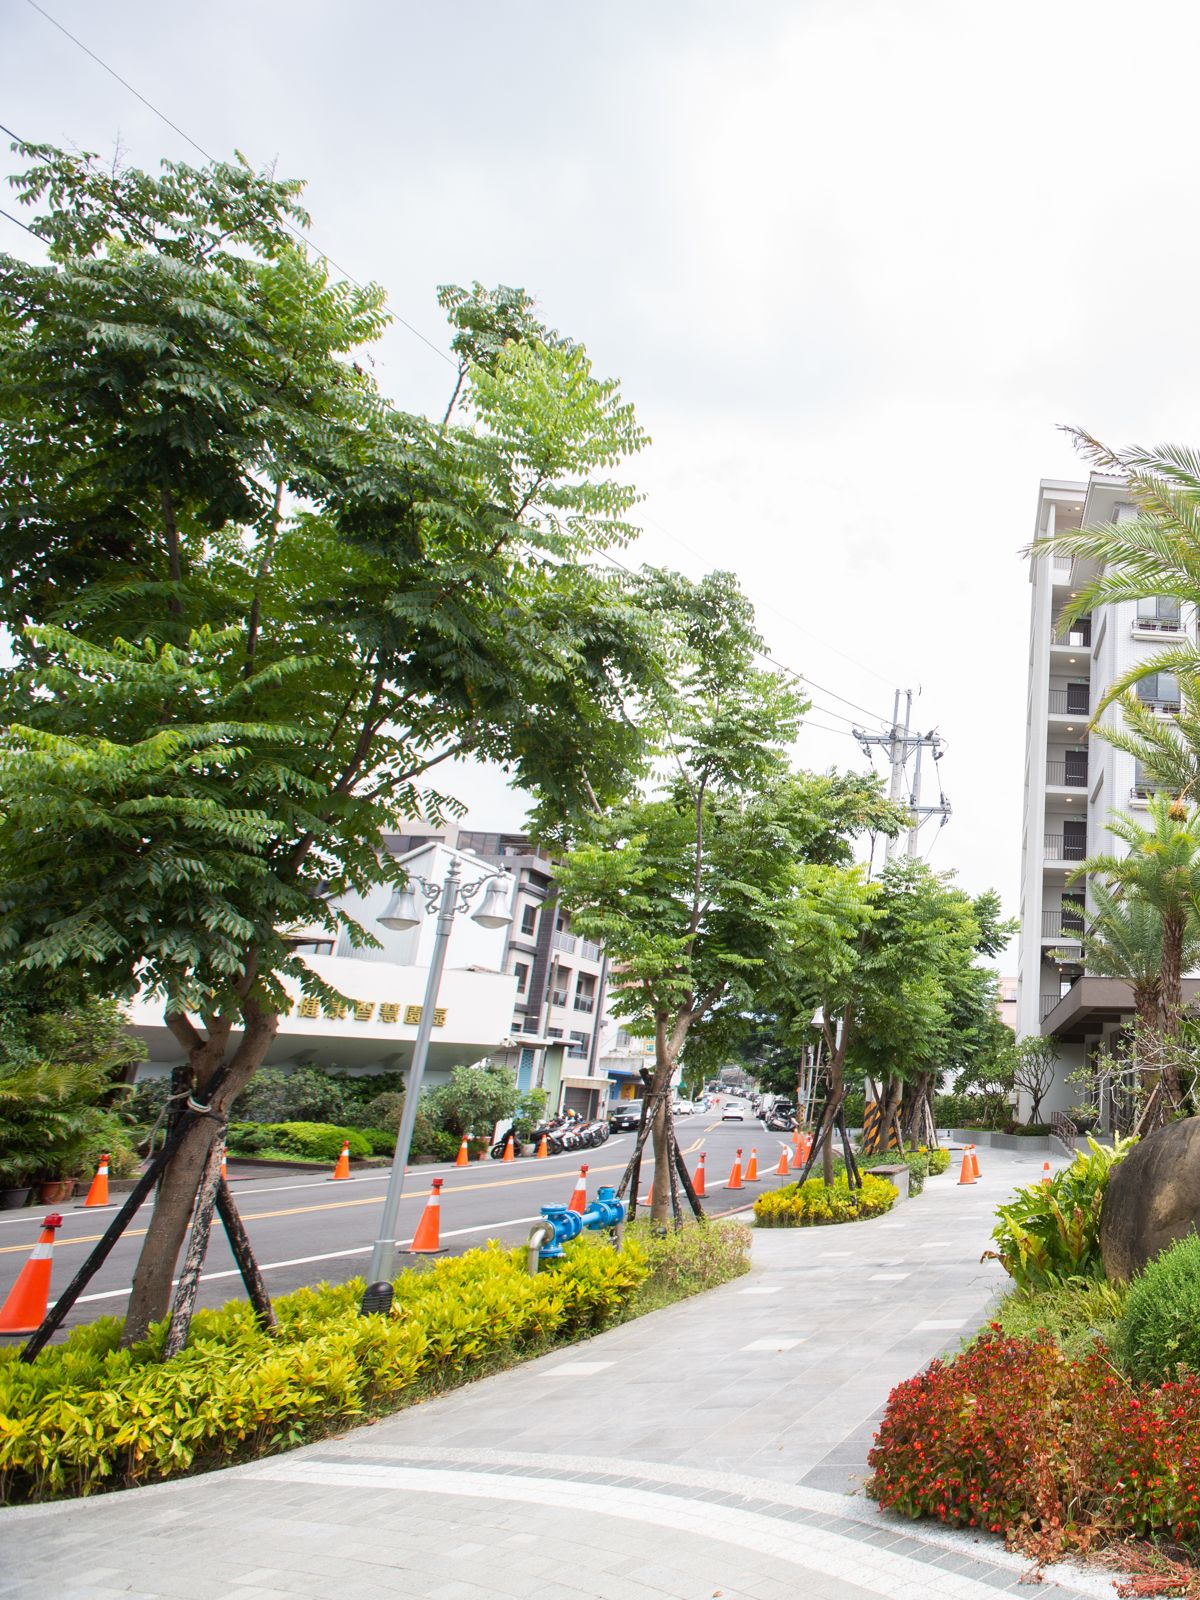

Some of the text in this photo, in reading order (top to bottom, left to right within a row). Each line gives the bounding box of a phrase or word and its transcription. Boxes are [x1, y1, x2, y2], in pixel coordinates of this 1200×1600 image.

[288, 996, 448, 1027] 健康智慧園區
